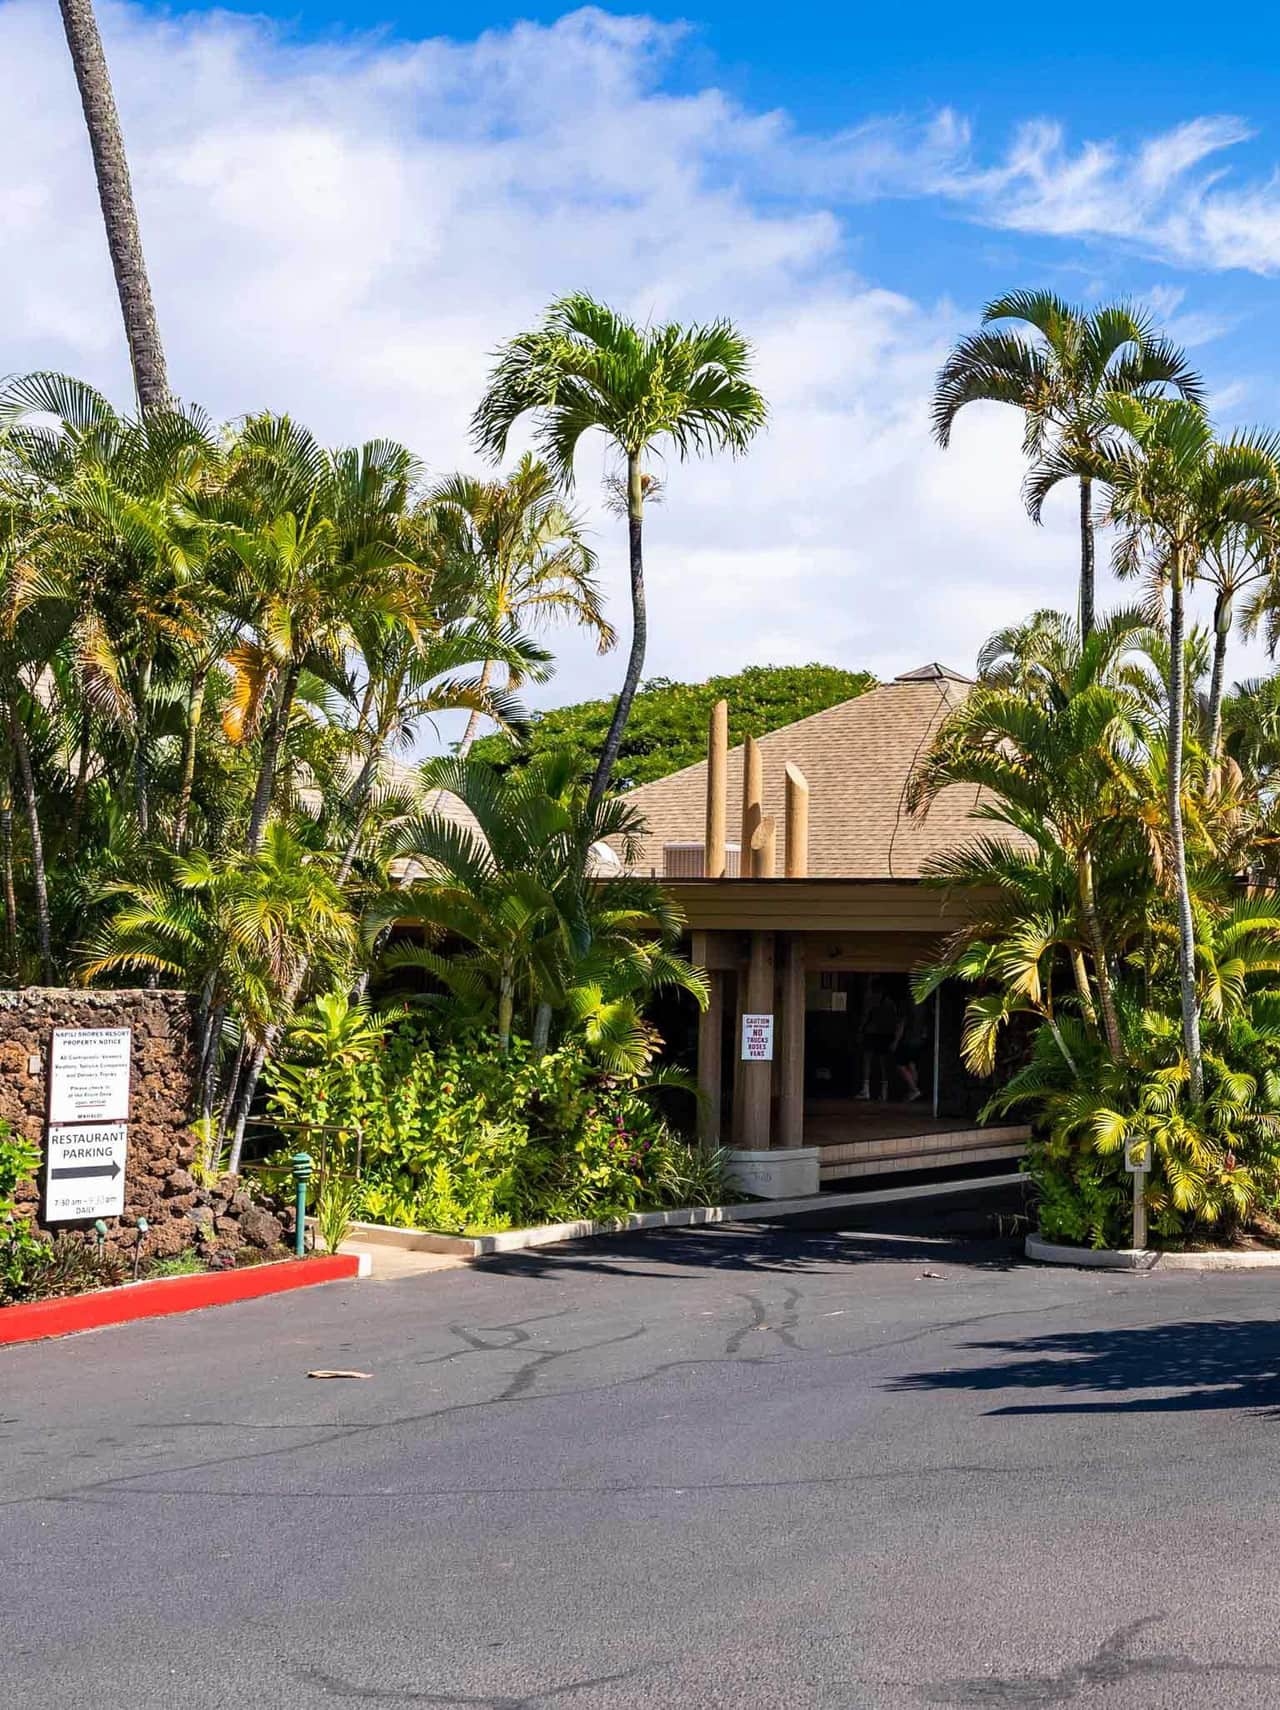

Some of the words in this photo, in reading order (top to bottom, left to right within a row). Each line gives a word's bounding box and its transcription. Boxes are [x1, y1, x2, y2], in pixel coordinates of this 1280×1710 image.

[51, 1131, 125, 1145] RESTAURANT
[63, 1146, 113, 1159] PARKING
[76, 1206, 95, 1215] DAILY
